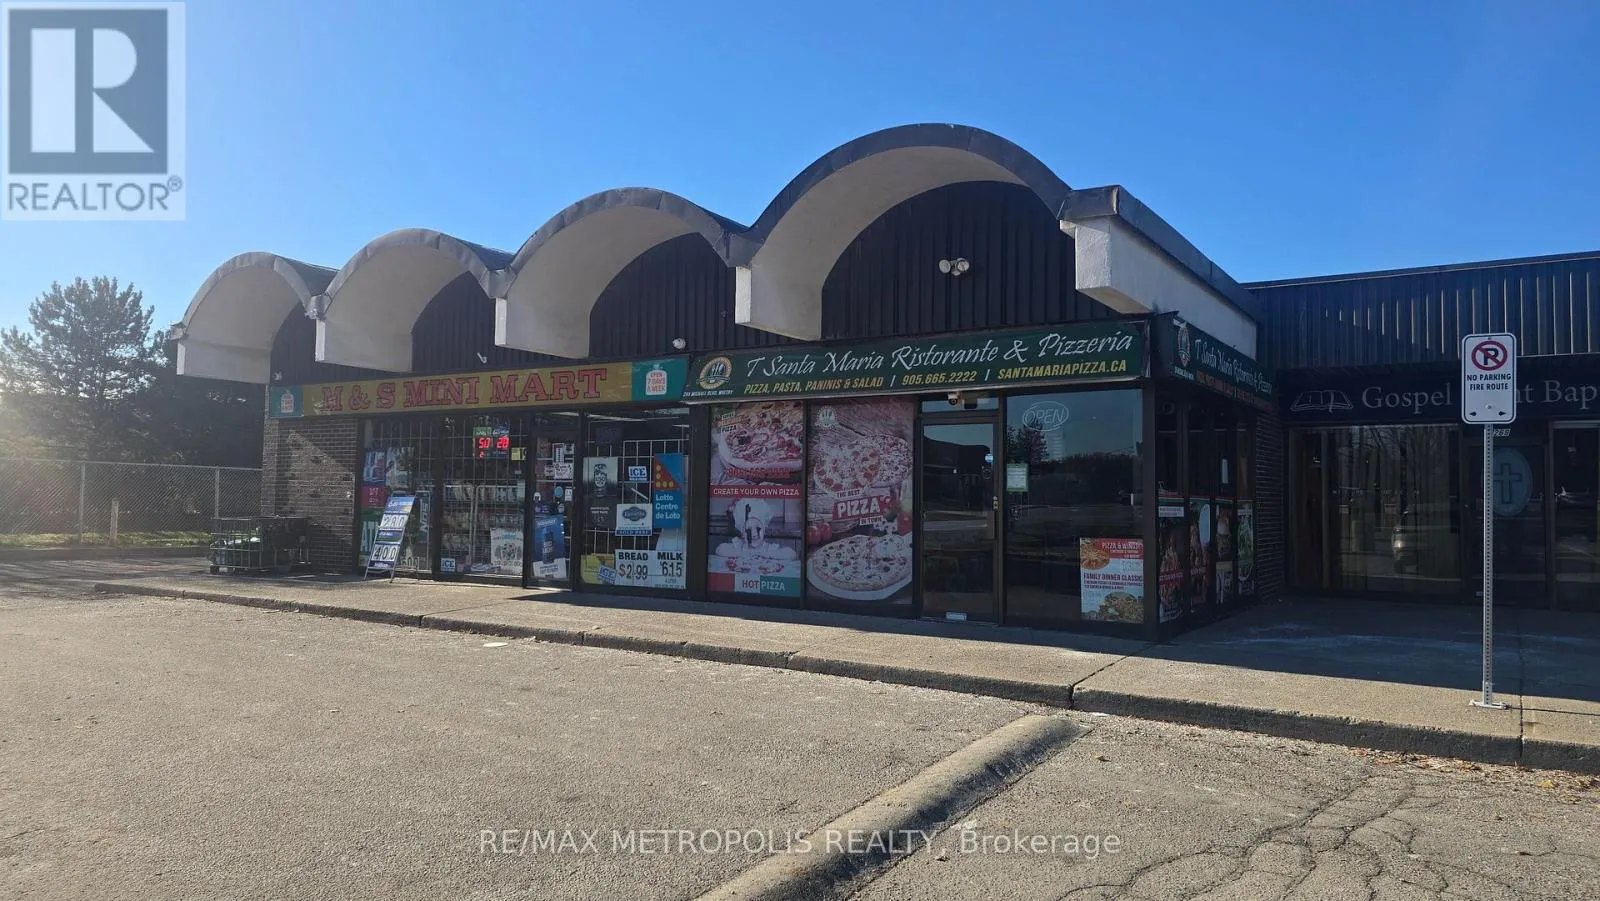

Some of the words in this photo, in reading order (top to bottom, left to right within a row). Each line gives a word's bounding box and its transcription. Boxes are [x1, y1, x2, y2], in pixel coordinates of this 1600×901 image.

[747, 357, 765, 377] T
[763, 354, 816, 377] Santa
[822, 350, 883, 373] Maria
[892, 340, 998, 370] Ristorante
[1003, 340, 1028, 362] &
[1038, 330, 1133, 358] Pizzeria
[744, 382, 770, 394] PIZZA,
[773, 381, 802, 393] PASTA,
[805, 380, 842, 392] PANINIS
[844, 379, 851, 388] &
[852, 376, 883, 388] SALAD
[902, 371, 977, 385] 905.665.2222
[998, 360, 1127, 379] SANTAMARIAPIZZA.CA
[348, 384, 371, 410] &
[377, 382, 396, 409] S
[403, 377, 480, 407] MINI
[490, 368, 608, 404] MART
[1362, 383, 1452, 414] Gospel
[1024, 408, 1065, 424] OPEN
[740, 488, 759, 496] YOUR
[760, 488, 778, 496] OWN
[780, 488, 800, 496] PIZZA
[837, 497, 880, 518] PIZZA
[618, 552, 648, 560] BREAD
[658, 552, 684, 560] MILK
[742, 580, 759, 588] HOT
[761, 581, 785, 591] PIZZA
